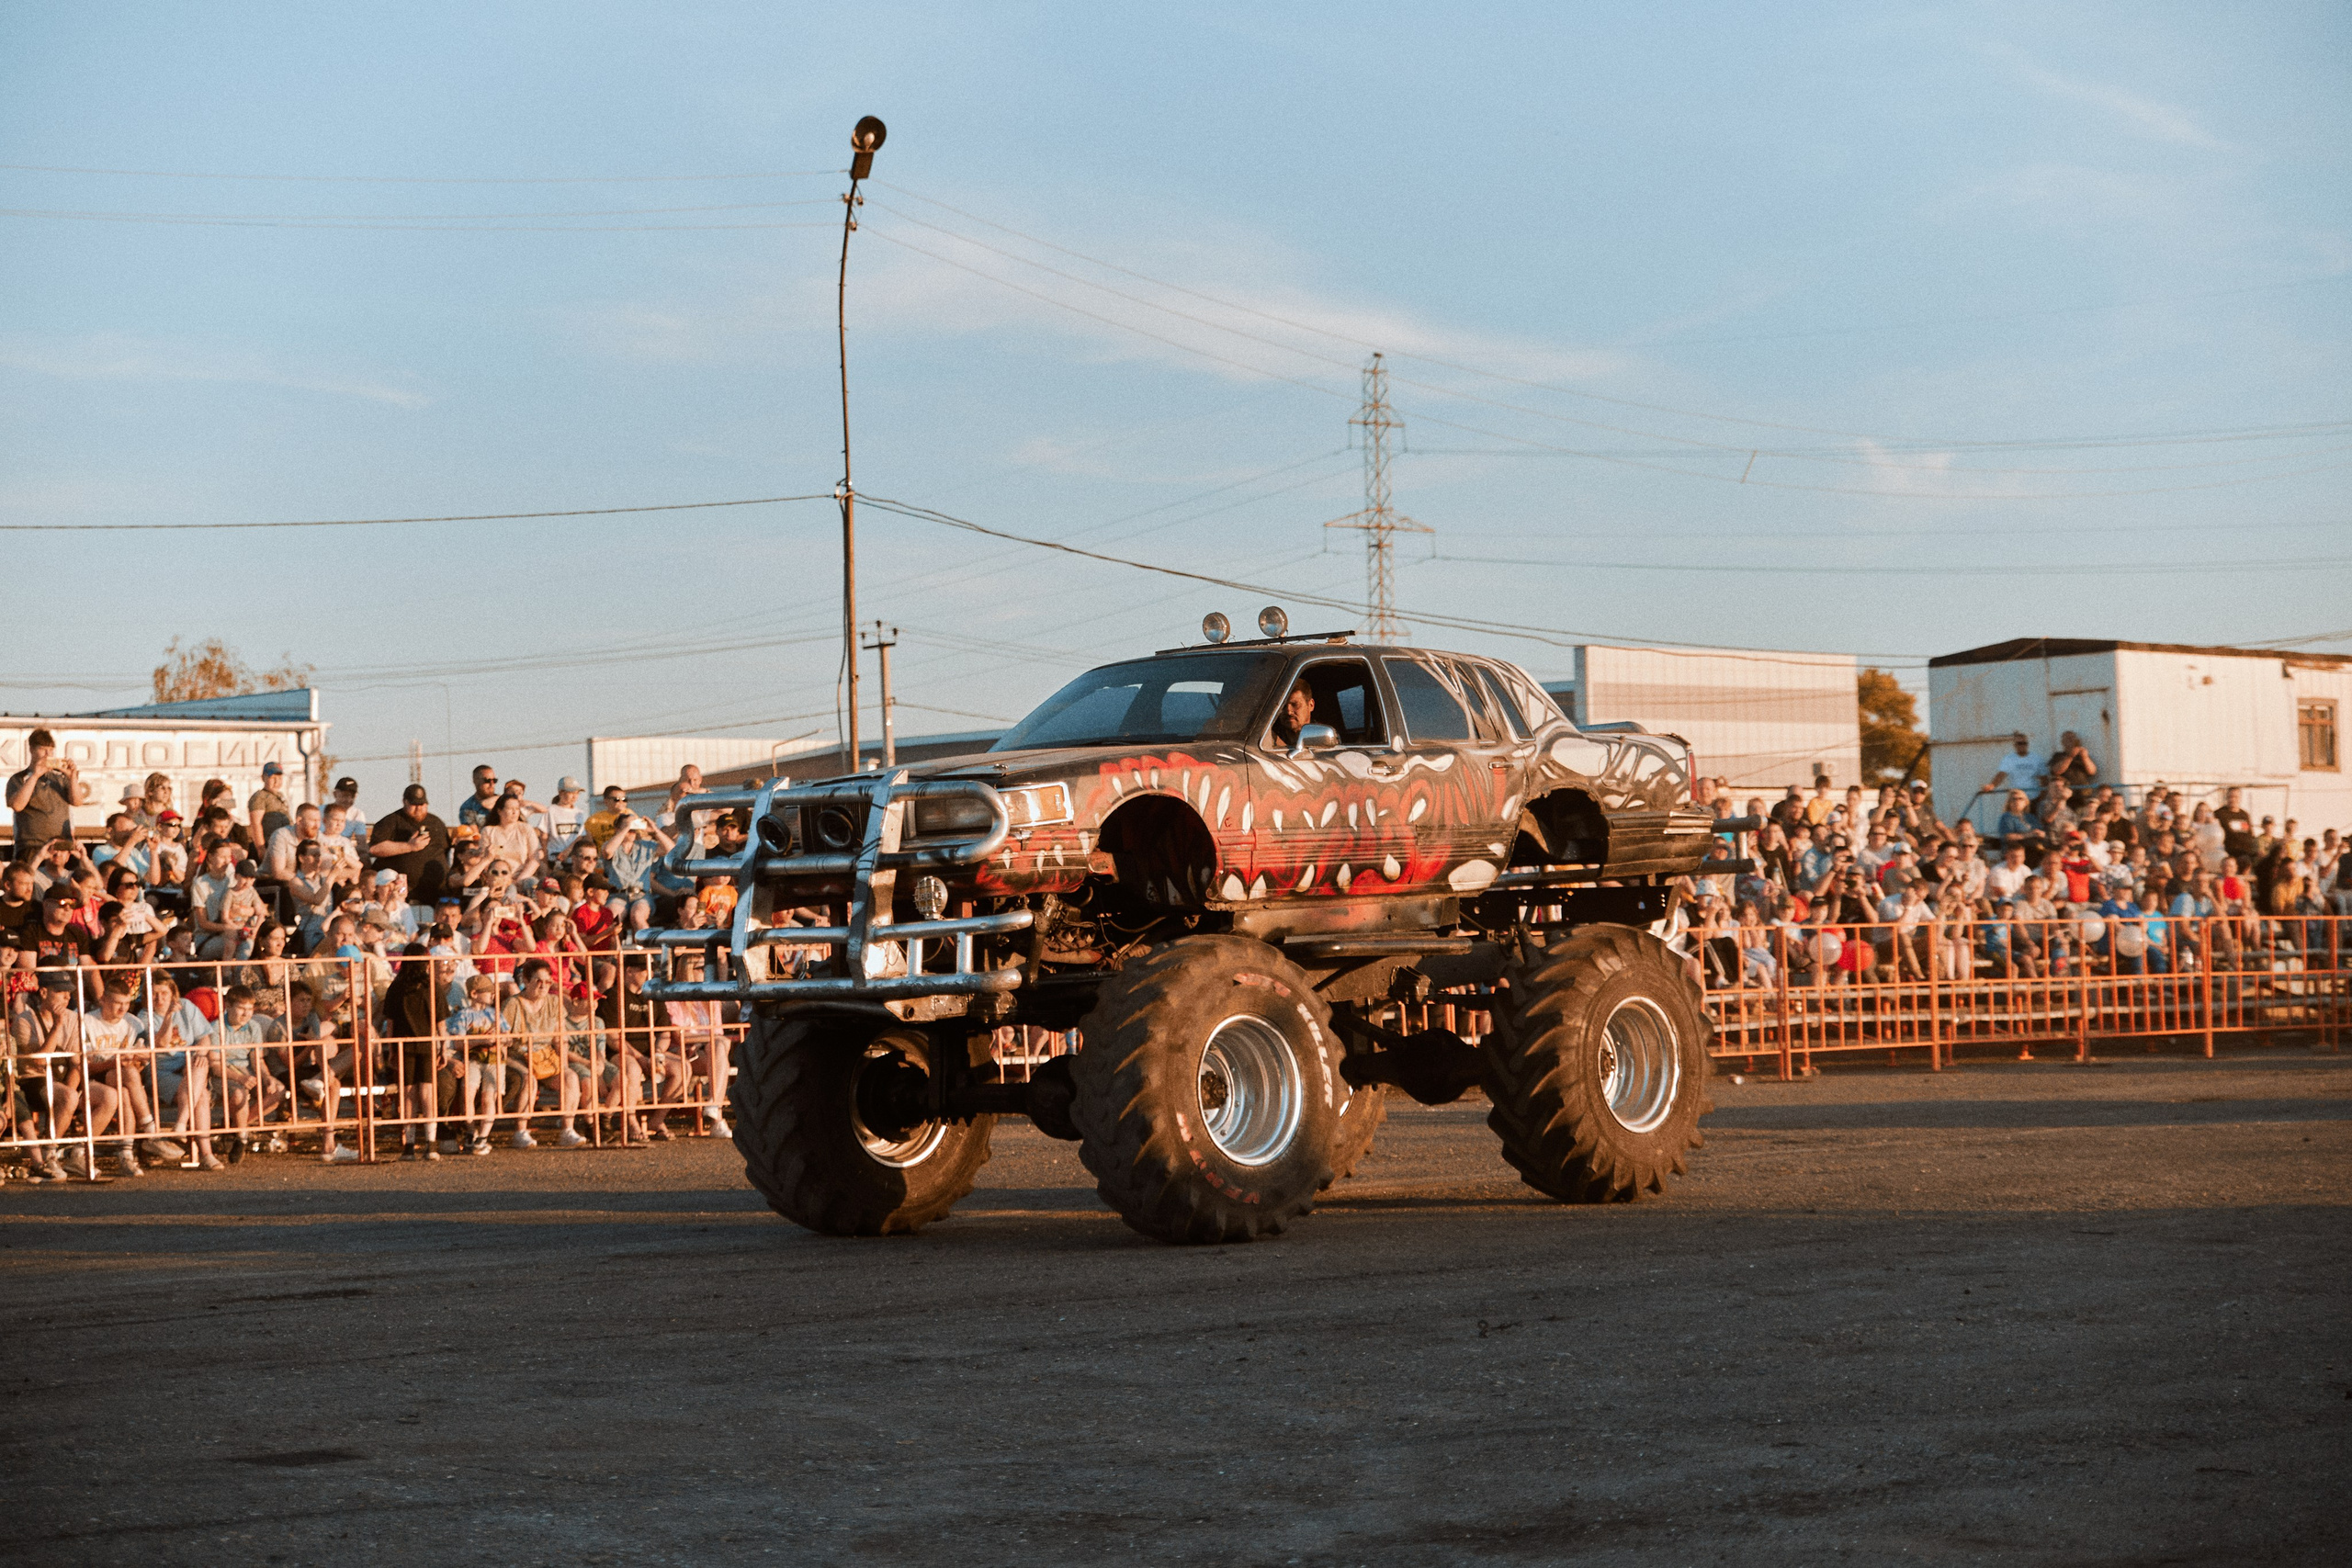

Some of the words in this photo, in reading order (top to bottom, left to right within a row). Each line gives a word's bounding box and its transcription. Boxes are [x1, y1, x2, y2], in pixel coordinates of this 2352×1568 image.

[96, 1034, 129, 1051] FILA
[1296, 1002, 1333, 1109] KILLER
[1176, 1111, 1260, 1204] VENOM
